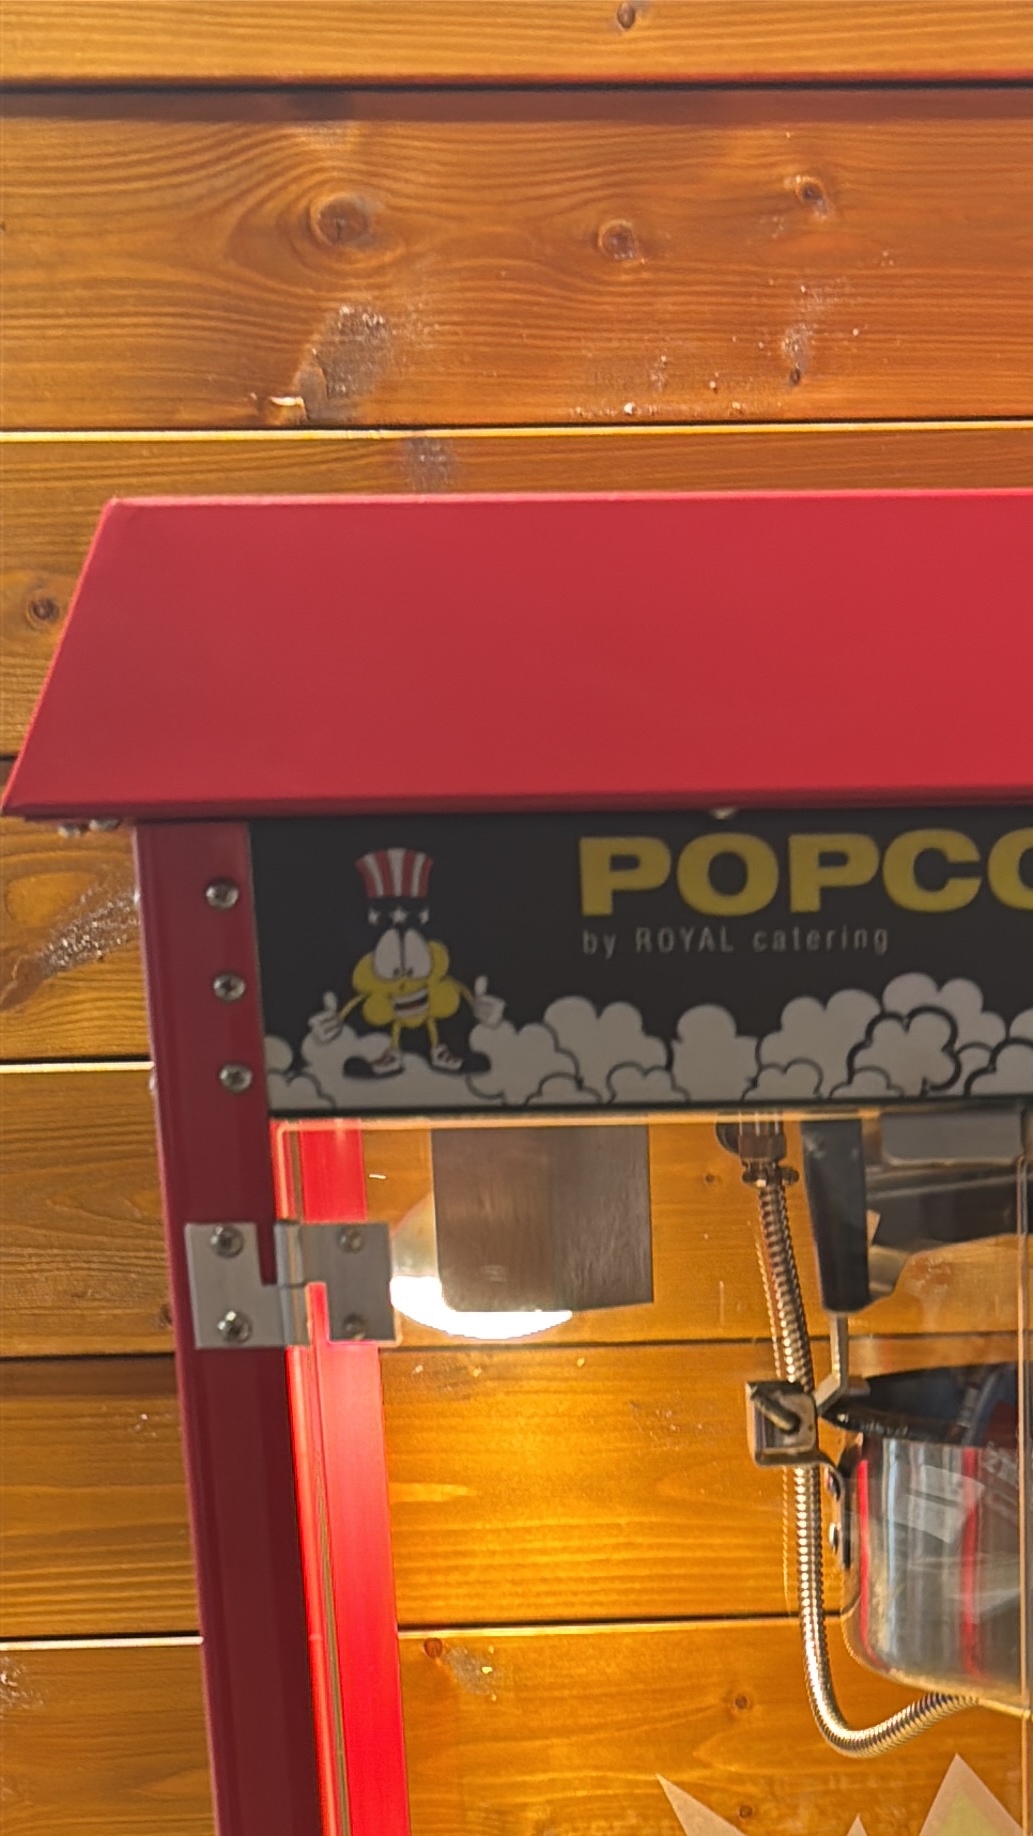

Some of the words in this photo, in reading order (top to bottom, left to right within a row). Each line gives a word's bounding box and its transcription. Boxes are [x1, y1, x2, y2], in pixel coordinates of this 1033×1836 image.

[582, 929, 618, 959] by
[635, 925, 735, 953] ROYAL
[752, 923, 890, 956] catering
